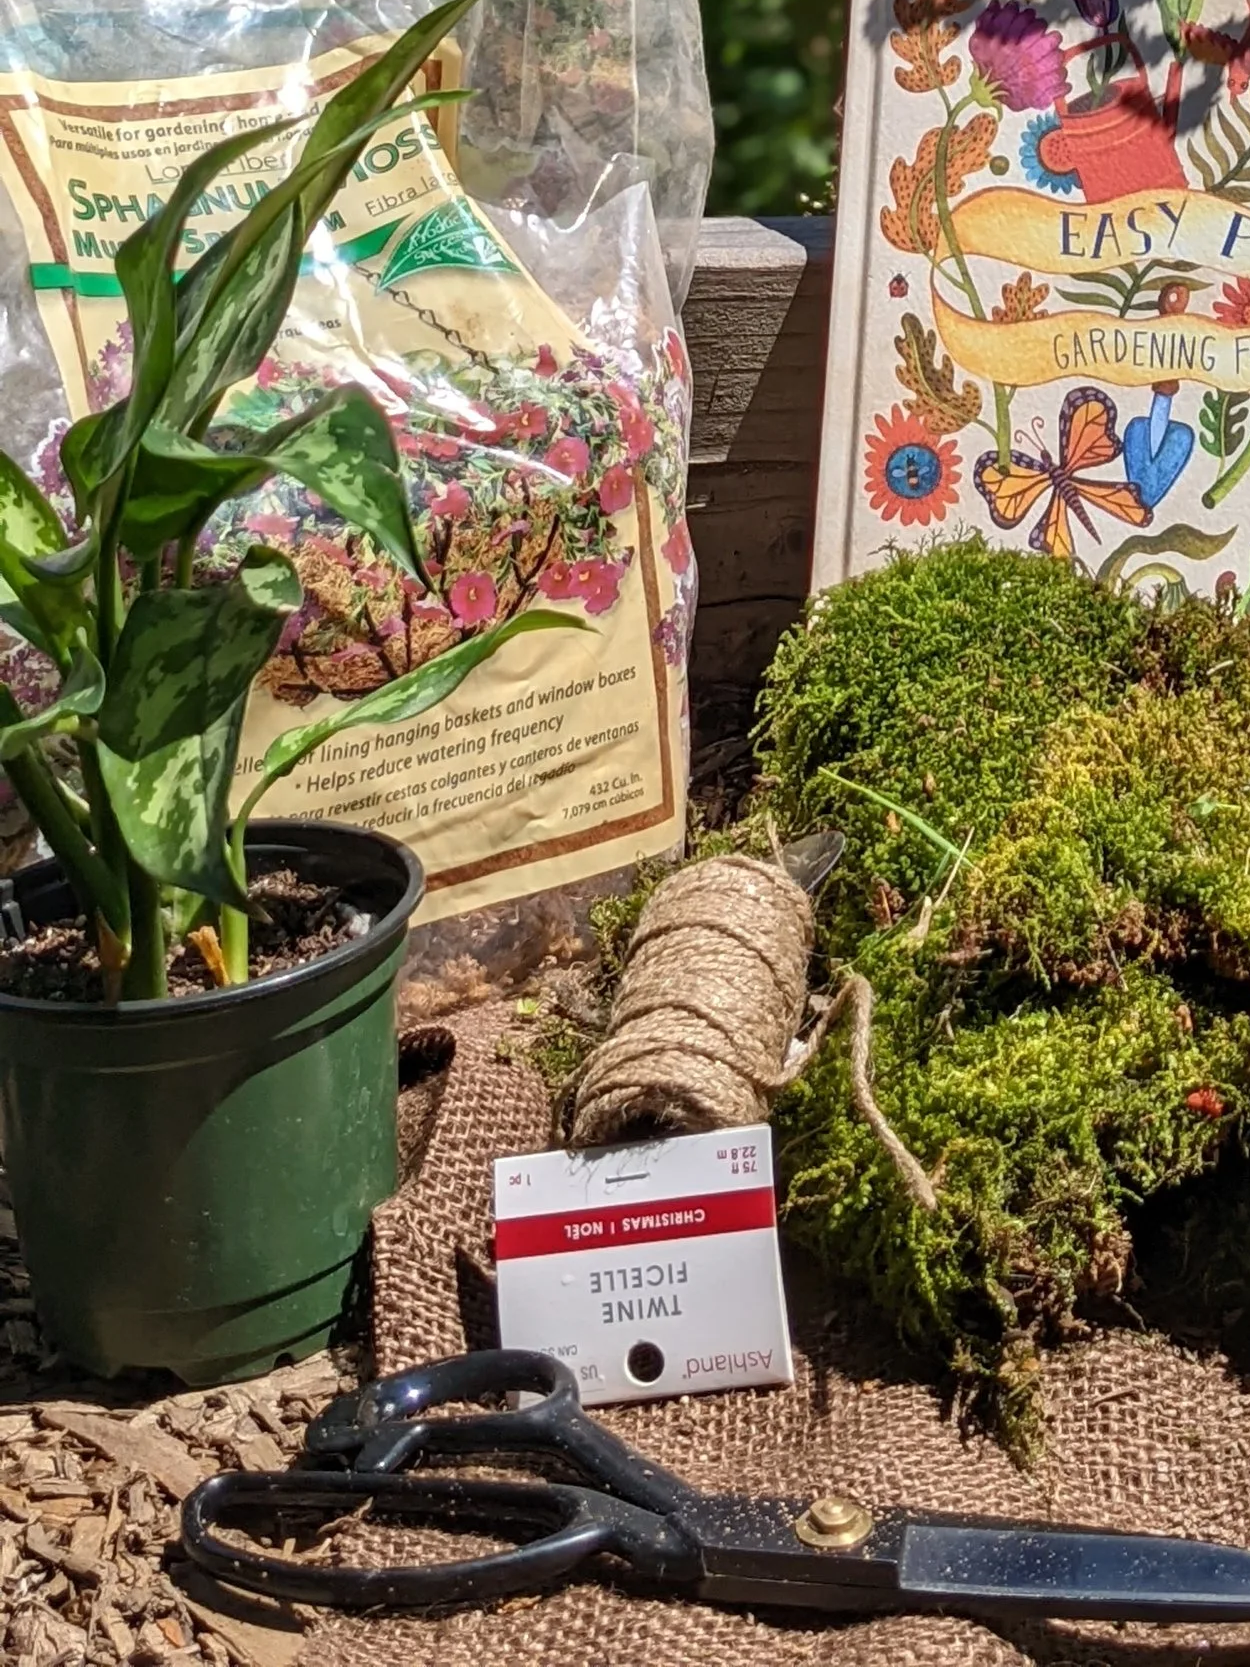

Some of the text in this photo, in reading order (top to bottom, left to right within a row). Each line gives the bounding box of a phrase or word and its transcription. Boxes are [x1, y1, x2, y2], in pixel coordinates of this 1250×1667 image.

[58, 118, 114, 141] Versatile
[116, 127, 140, 142] for
[50, 134, 73, 150] Para
[122, 147, 152, 160] usos
[154, 145, 171, 156] en
[145, 163, 188, 182] Lon
[365, 186, 417, 216] Fibra
[1059, 199, 1187, 259] EASY
[1053, 328, 1216, 373] GARDENING
[321, 740, 370, 763] lining
[374, 721, 441, 751] hanging
[445, 704, 502, 732] baskets
[506, 690, 535, 715] and
[538, 678, 595, 706] window
[598, 666, 636, 689] boxes
[306, 714, 564, 794] Helps reduce watering frequency
[328, 791, 382, 817] revestir
[385, 781, 427, 803] cestas
[430, 762, 496, 791] colgantes
[498, 759, 507, 777] y
[510, 744, 563, 770] canteros
[566, 736, 582, 753] de
[584, 721, 639, 747] ventanas
[590, 771, 643, 796] 432 Cu. In.
[361, 806, 414, 830] reducir
[416, 802, 429, 819] la
[432, 783, 503, 814] frecuencia
[507, 774, 525, 794] del
[562, 787, 645, 821] 7,079 cm cúbicos
[716, 1145, 757, 1160] 22.8 m
[731, 1160, 758, 1175] 75 ft
[509, 1174, 522, 1186] pc
[564, 1208, 706, 1240] CHRISTMAS NOËL
[590, 1261, 688, 1293] FICELLE
[602, 1295, 683, 1324] TWINE
[559, 1343, 578, 1356] CAN
[687, 1348, 773, 1378] Ashland
[581, 1364, 599, 1381] US
